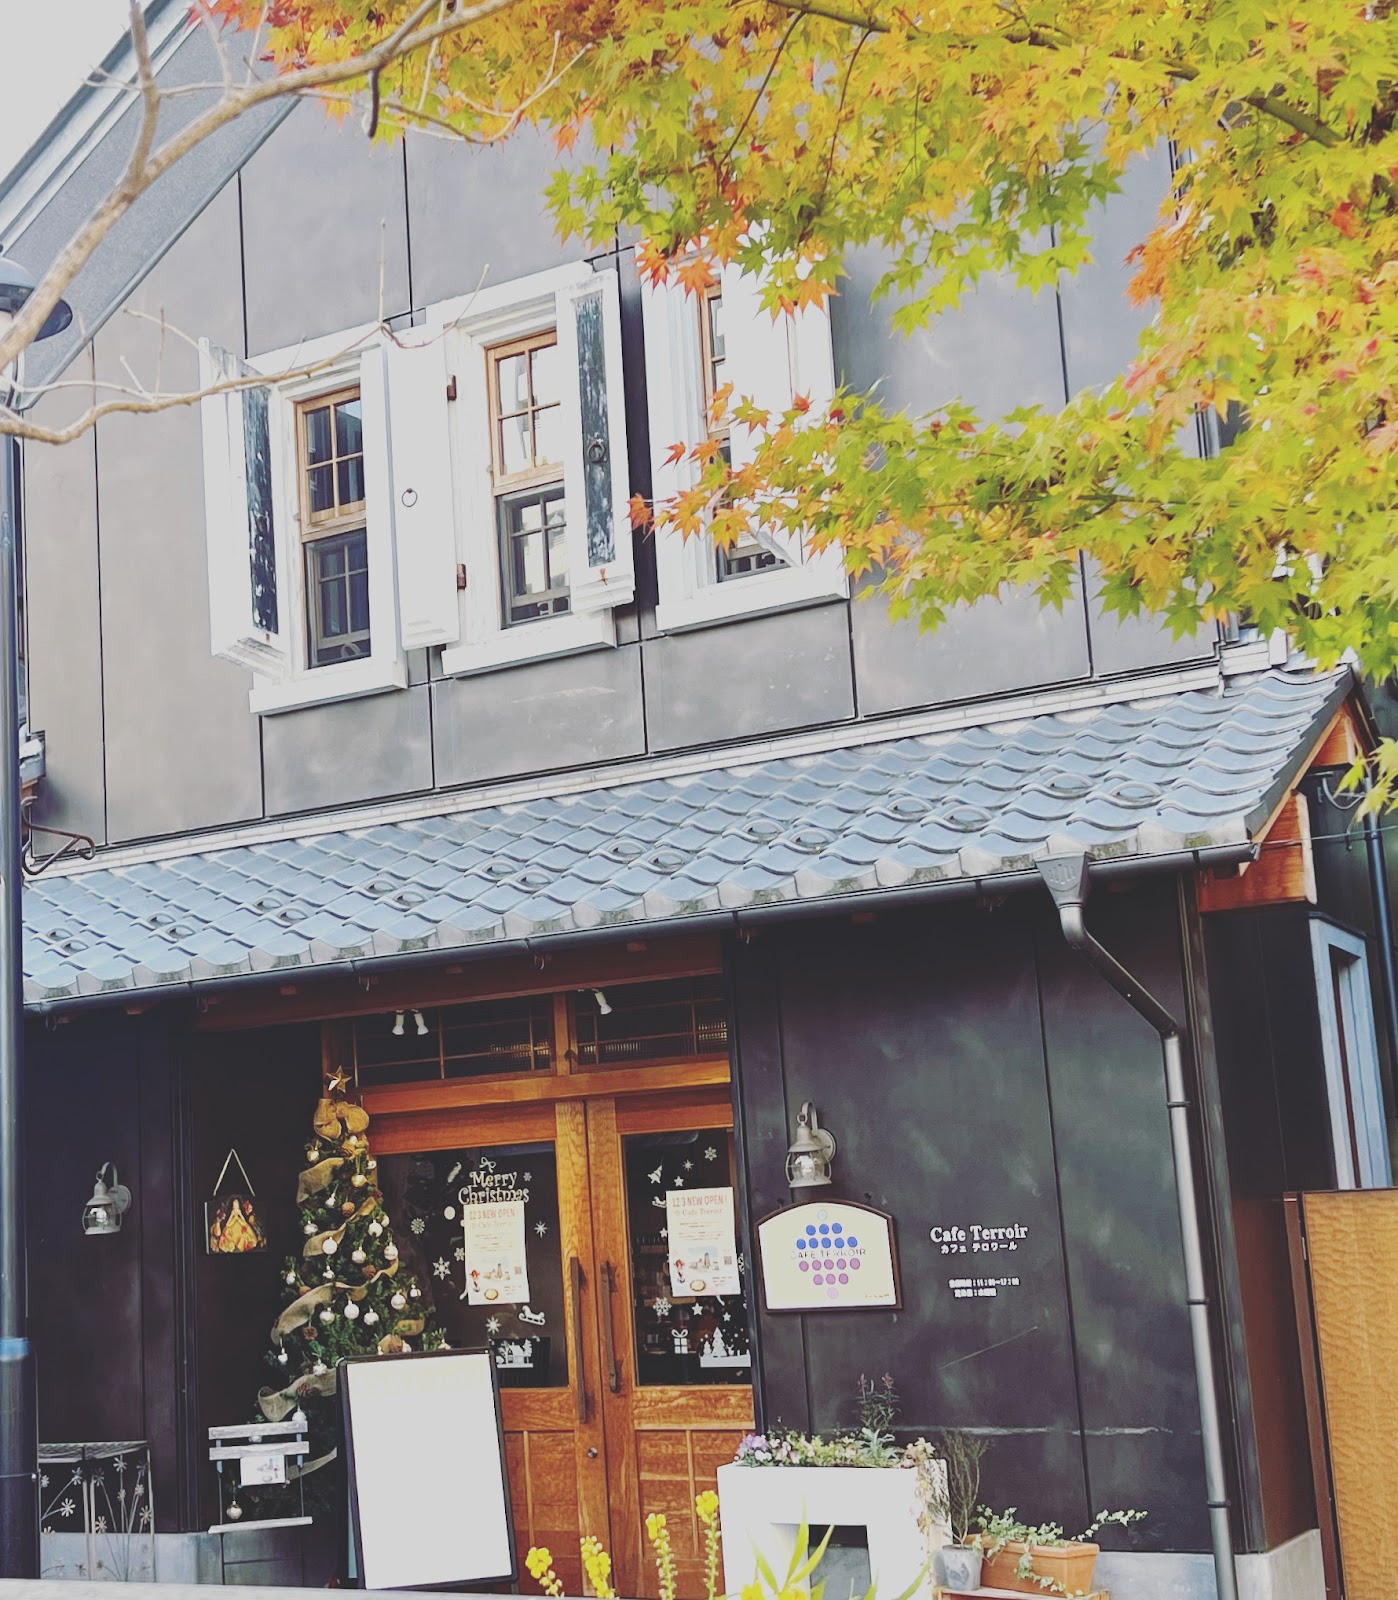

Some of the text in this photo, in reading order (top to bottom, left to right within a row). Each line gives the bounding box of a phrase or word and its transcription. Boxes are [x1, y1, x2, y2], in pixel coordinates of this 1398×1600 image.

[469, 1171, 518, 1190] Merry
[458, 1185, 530, 1205] Christmas
[687, 1196, 703, 1206] NEW
[482, 1209, 497, 1219] NEW
[930, 1223, 1028, 1243] Cafe Terroir
[940, 1241, 1018, 1254] カフェ テロワール
